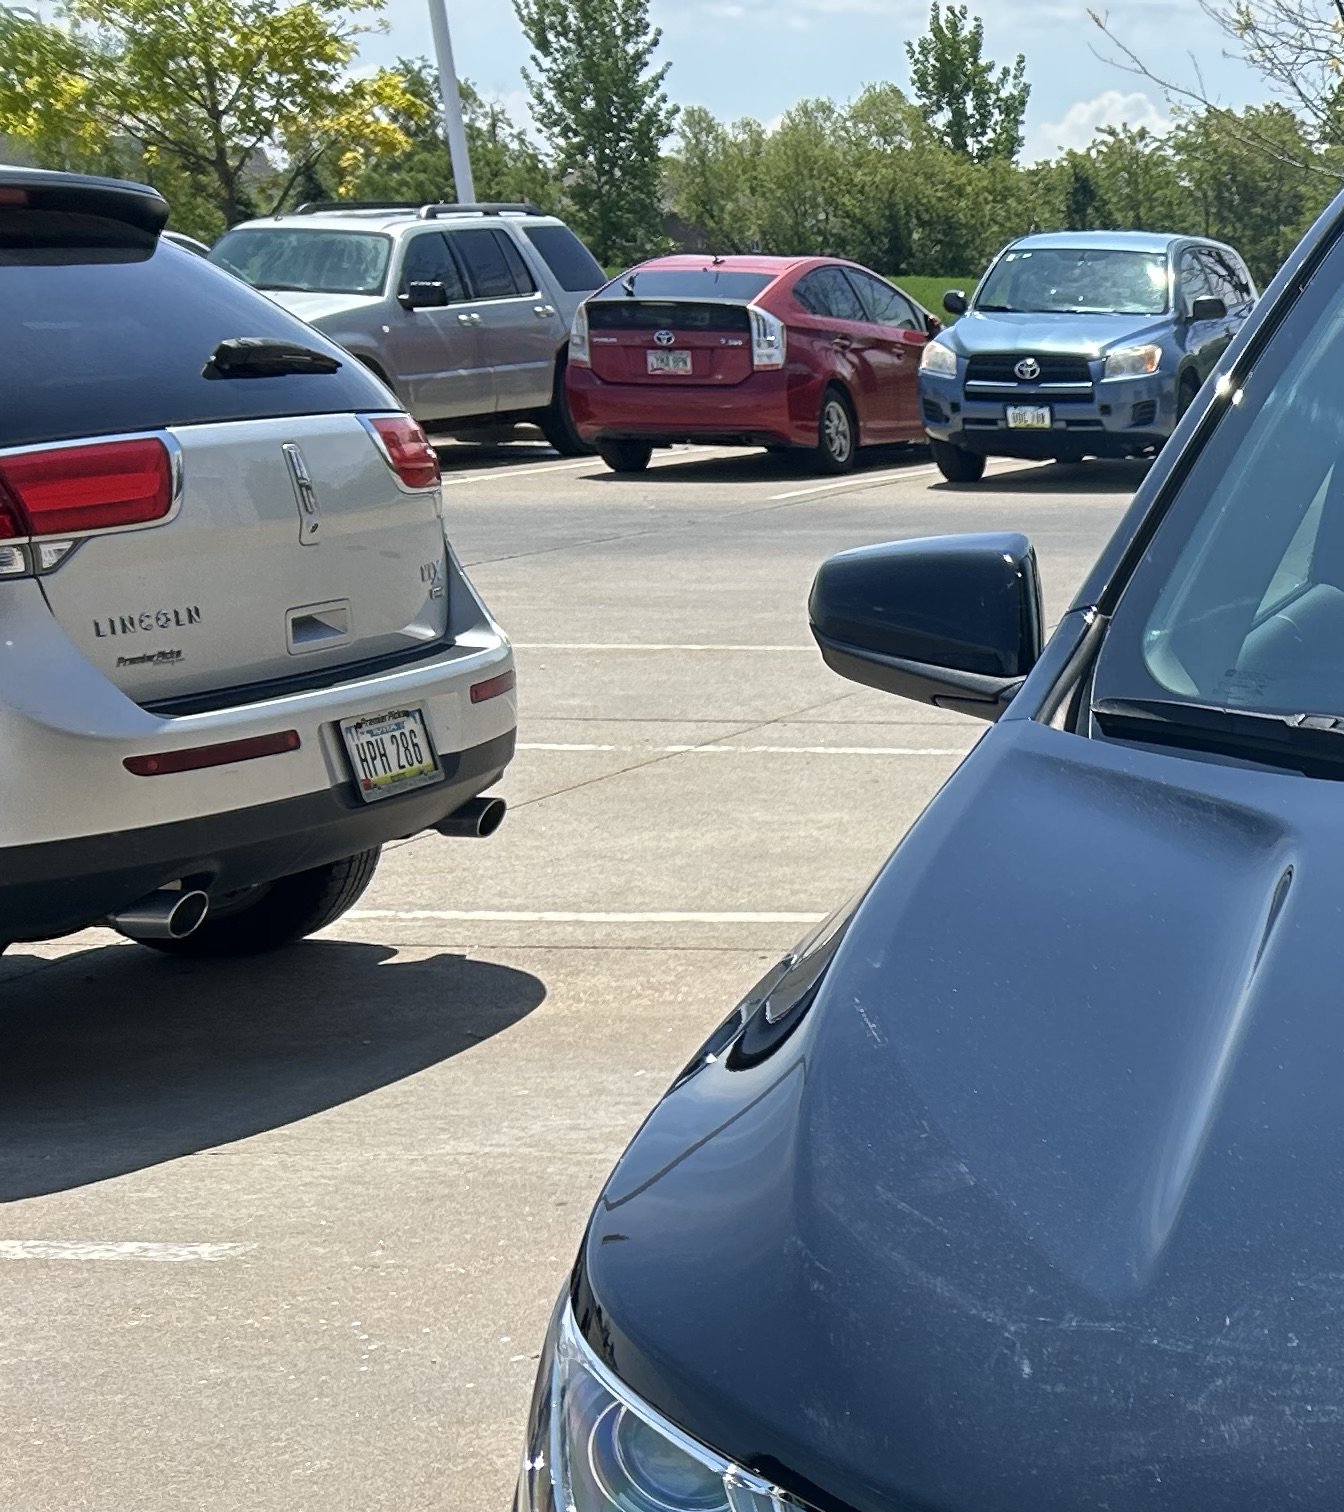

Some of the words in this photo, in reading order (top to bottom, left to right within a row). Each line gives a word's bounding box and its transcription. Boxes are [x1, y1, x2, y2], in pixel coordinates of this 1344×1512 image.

[93, 605, 201, 638] LINCOLN
[355, 736, 392, 779] HPH
[390, 728, 424, 769] 286
